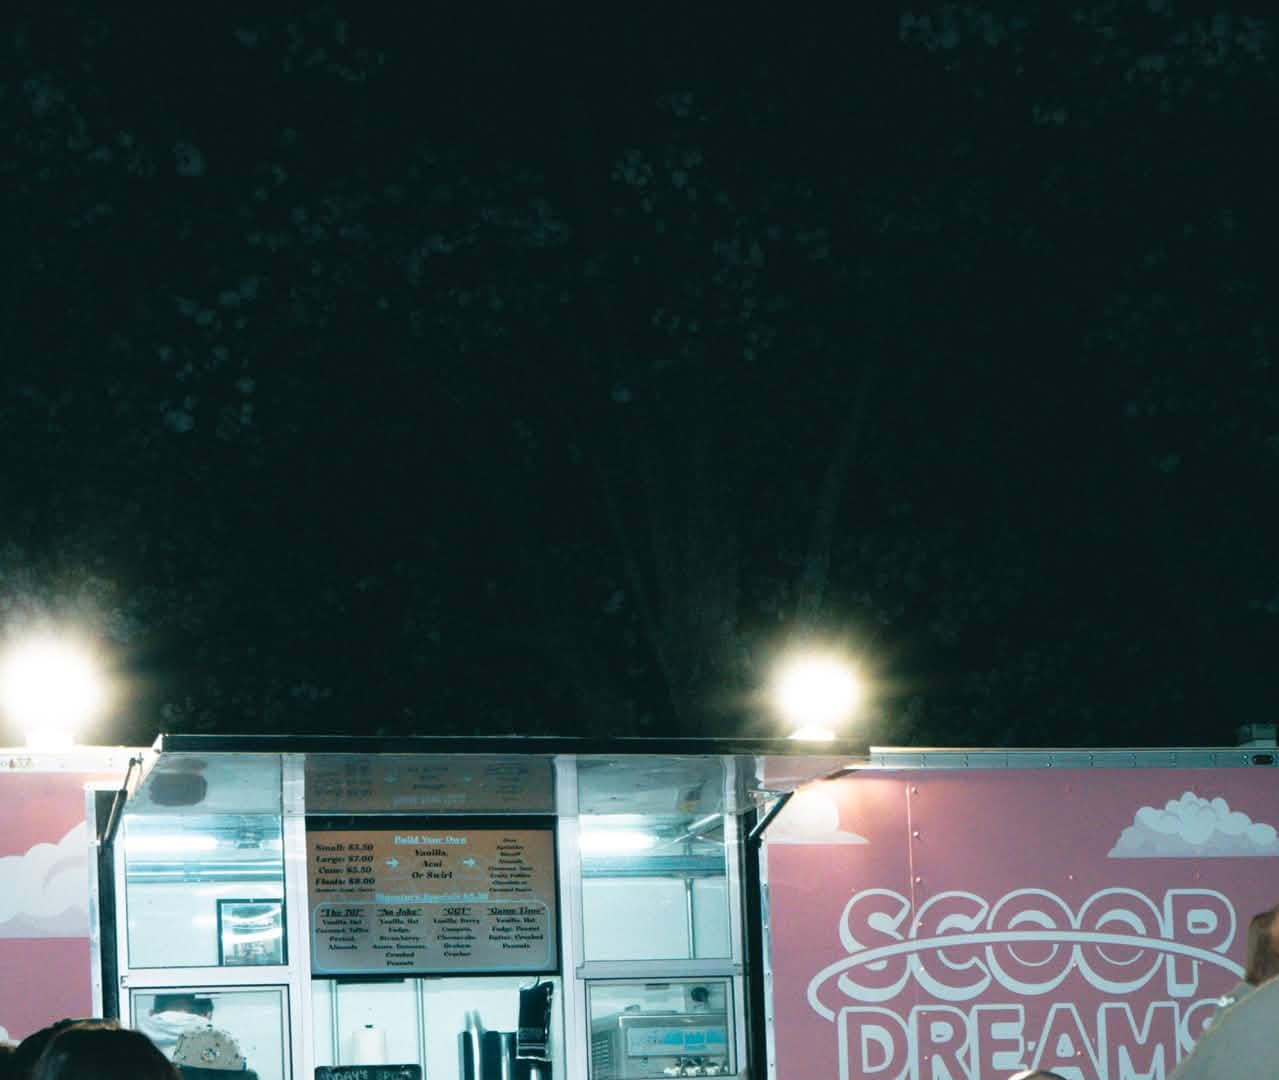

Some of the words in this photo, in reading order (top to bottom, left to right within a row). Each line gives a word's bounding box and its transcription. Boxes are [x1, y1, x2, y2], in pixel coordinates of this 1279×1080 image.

[315, 843, 345, 851] Small:
[415, 848, 449, 857] Vanilla,
[315, 855, 345, 864] Large:
[348, 855, 374, 863] $7.00
[318, 866, 345, 874] Cone:
[411, 871, 424, 879] Or
[426, 871, 453, 879] Swirl
[838, 887, 1237, 1001] SCOOP
